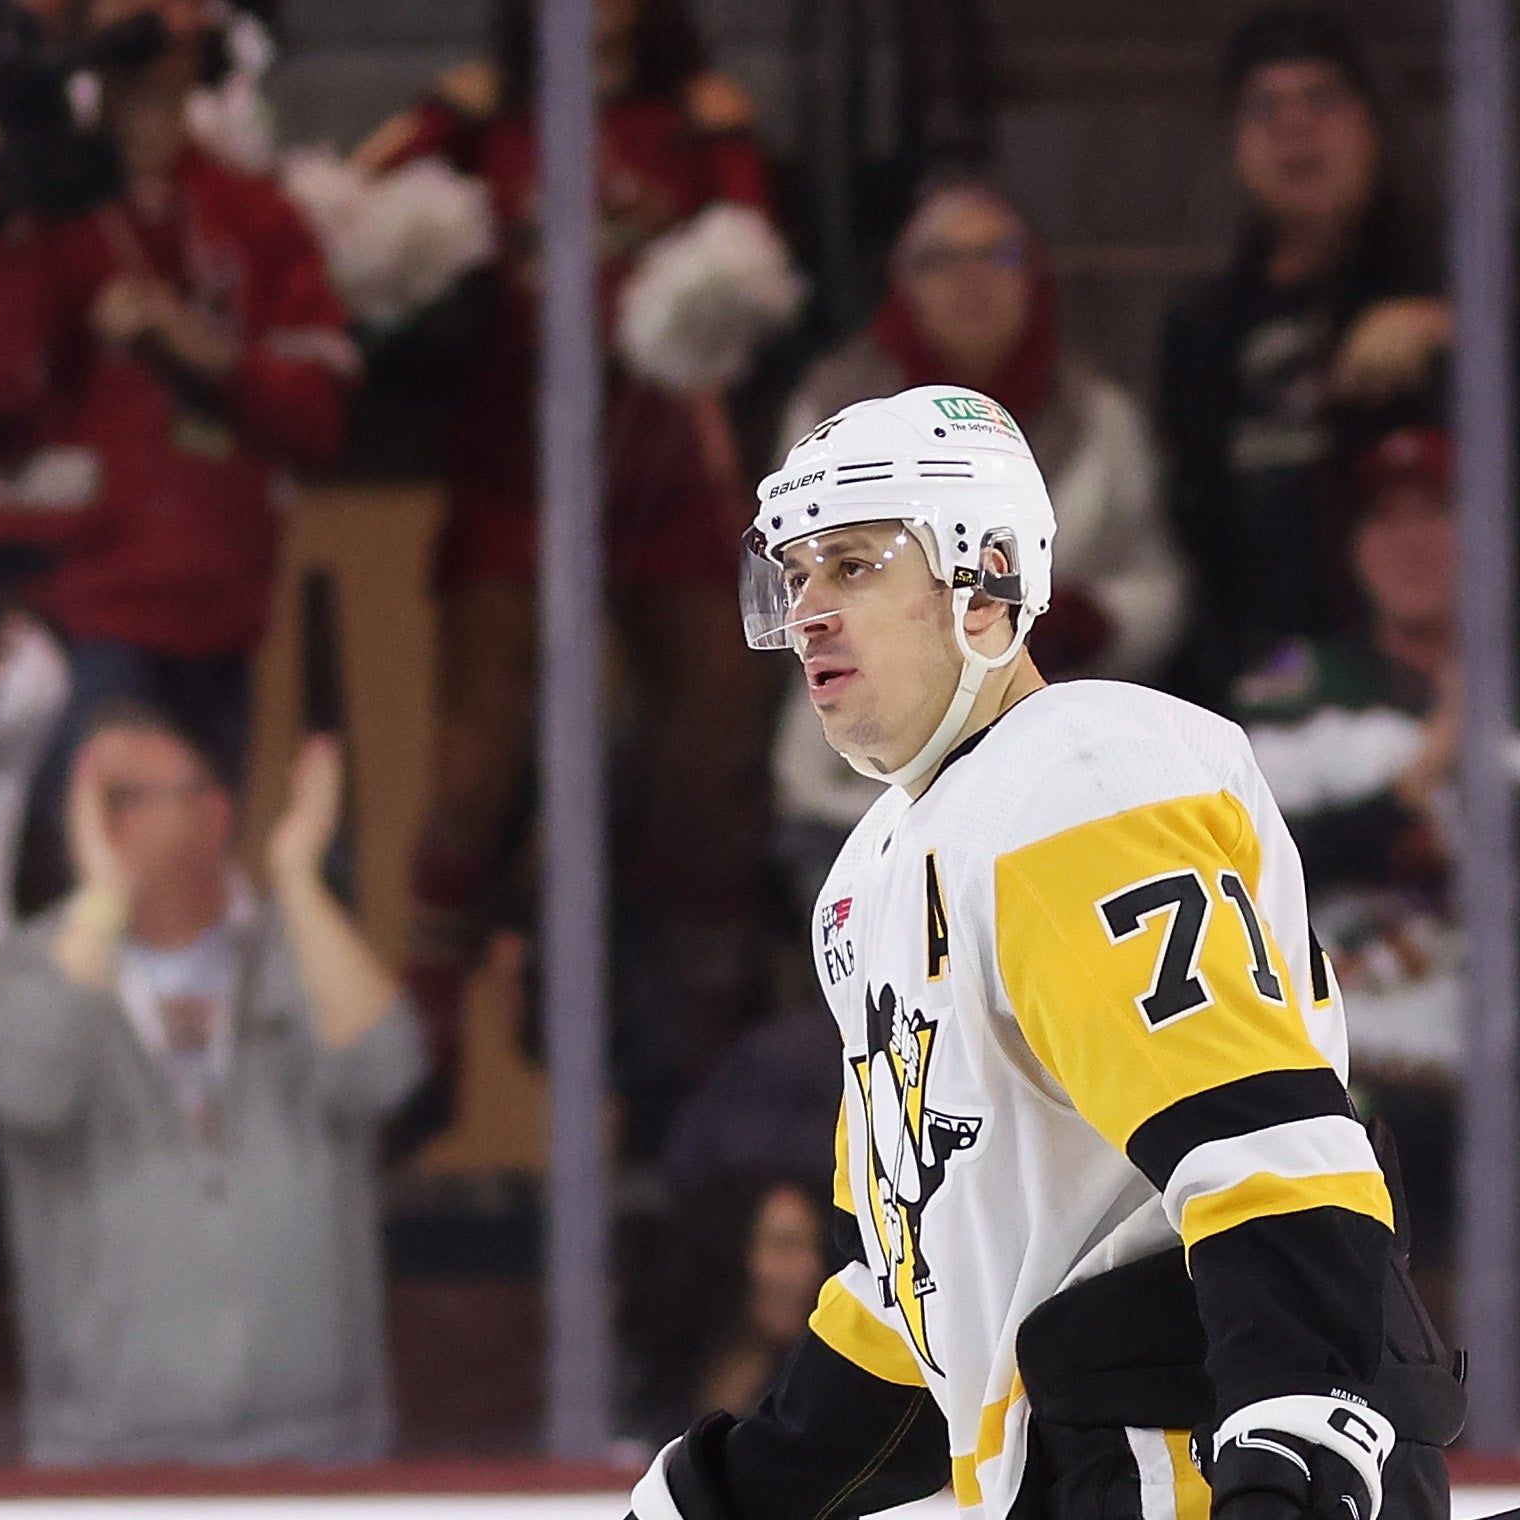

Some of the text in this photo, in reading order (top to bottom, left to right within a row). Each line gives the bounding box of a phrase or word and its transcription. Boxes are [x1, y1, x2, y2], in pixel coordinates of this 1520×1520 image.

[950, 423, 967, 432] The
[769, 470, 826, 499] BAUER
[1094, 868, 1287, 1033] 71
[1330, 1387, 1368, 1407] MALKIN
